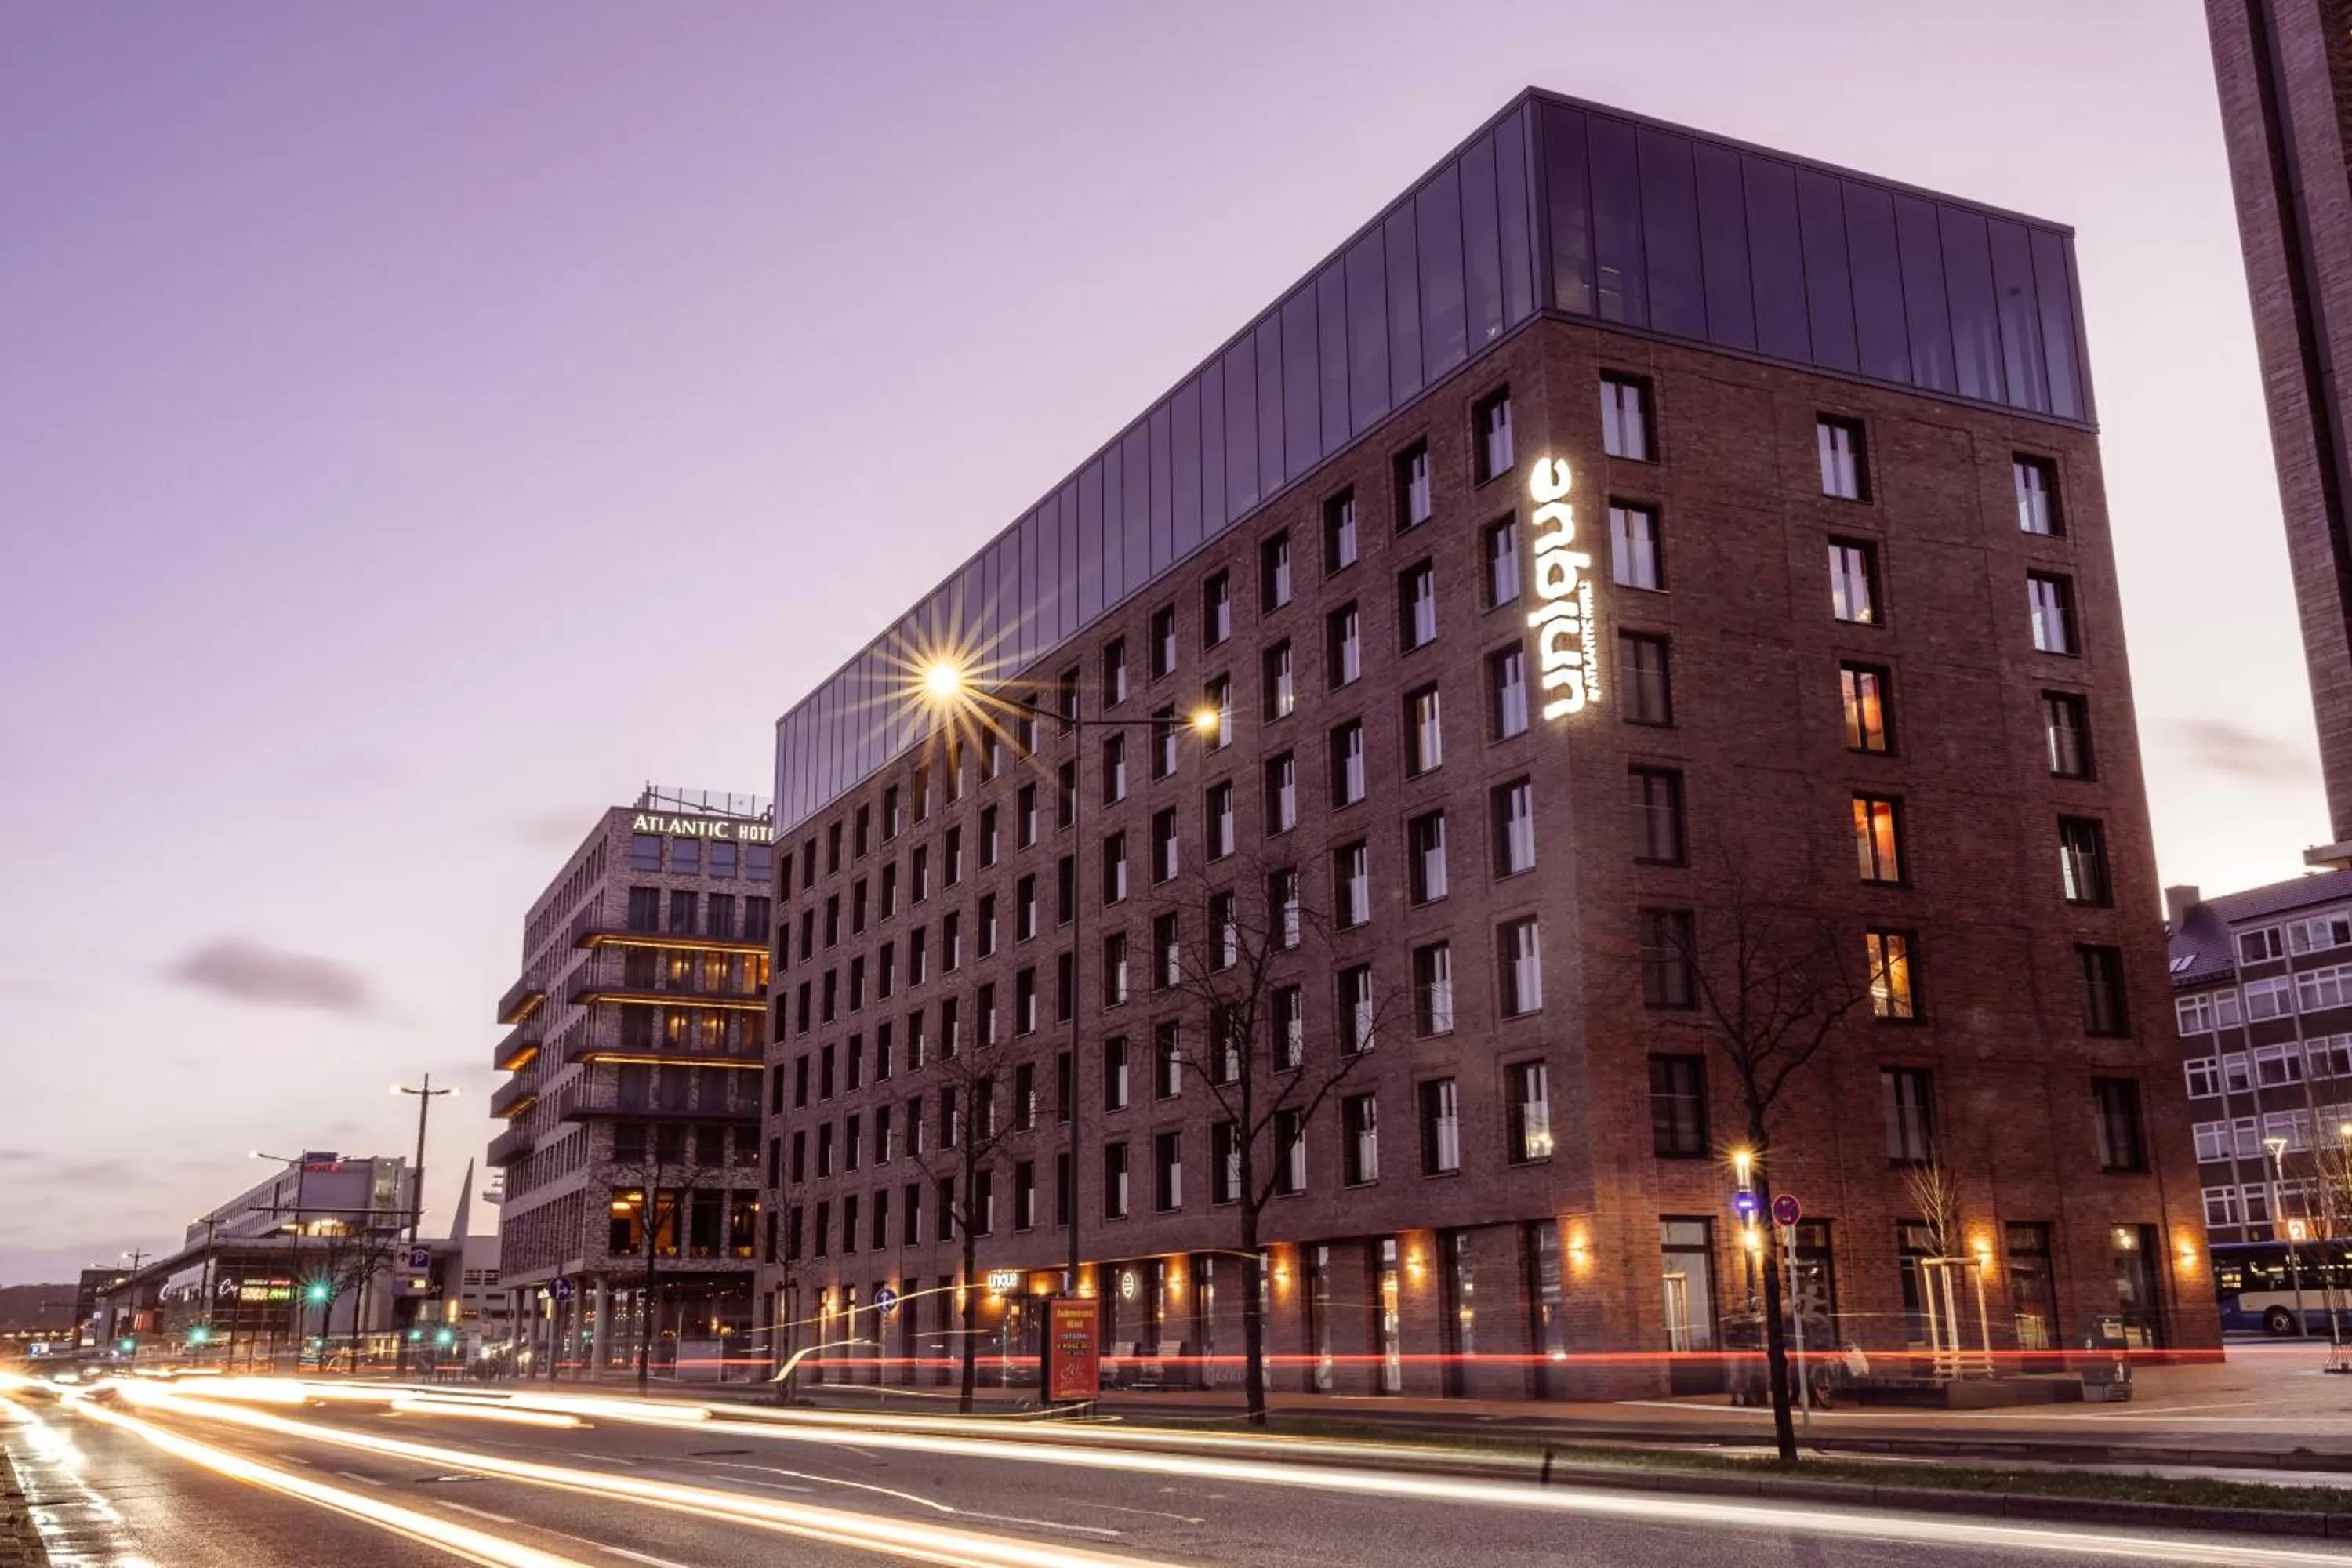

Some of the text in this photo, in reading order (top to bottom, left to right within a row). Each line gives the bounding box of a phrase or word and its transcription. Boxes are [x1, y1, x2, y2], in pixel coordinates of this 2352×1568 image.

[1528, 456, 1592, 720] unique
[633, 814, 729, 839] ATLANTIC
[988, 1269, 1018, 1289] unique
